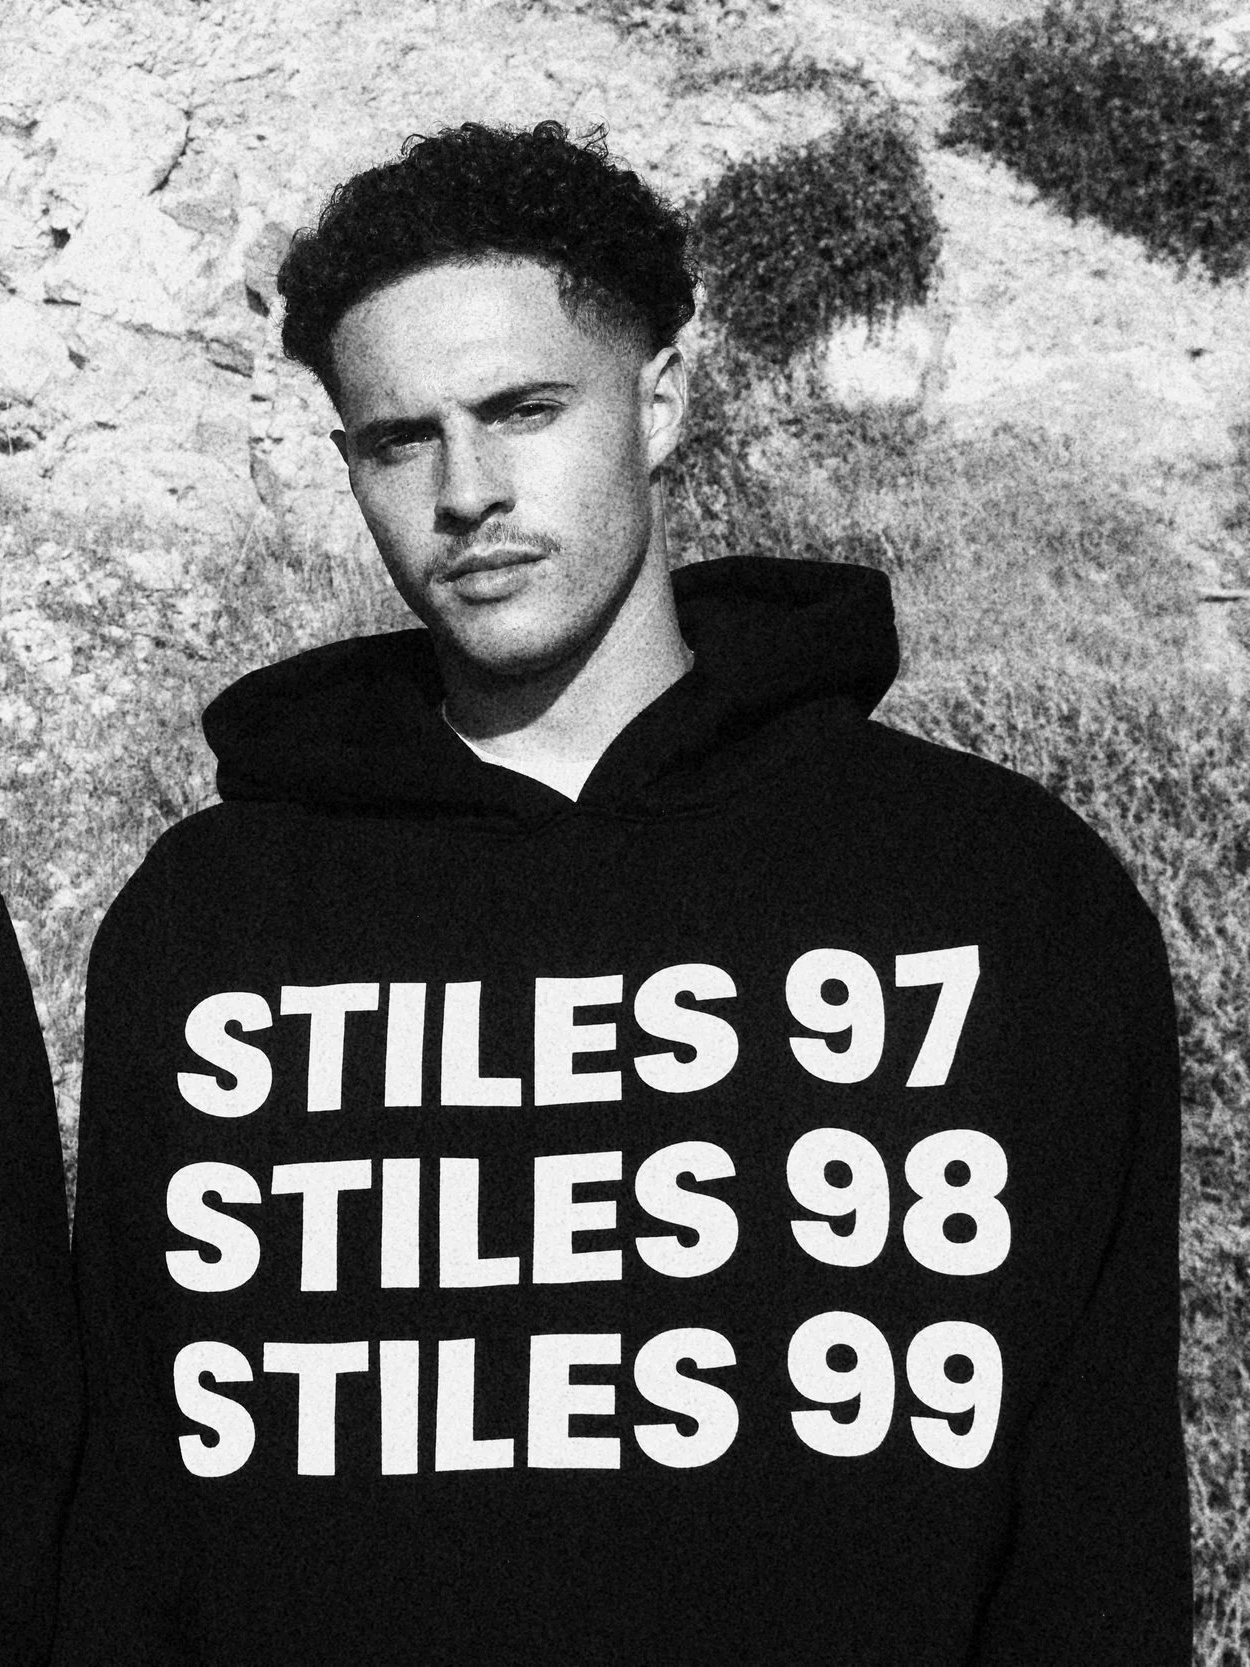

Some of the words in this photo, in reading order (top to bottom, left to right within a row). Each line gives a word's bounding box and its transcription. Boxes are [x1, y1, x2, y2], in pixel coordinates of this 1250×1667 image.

[177, 963, 739, 1118] STILES
[785, 945, 981, 1088] 97
[165, 1140, 739, 1293] STILES
[786, 1127, 1012, 1276] 98
[173, 1327, 740, 1478] STILES
[787, 1310, 1004, 1469] 99
